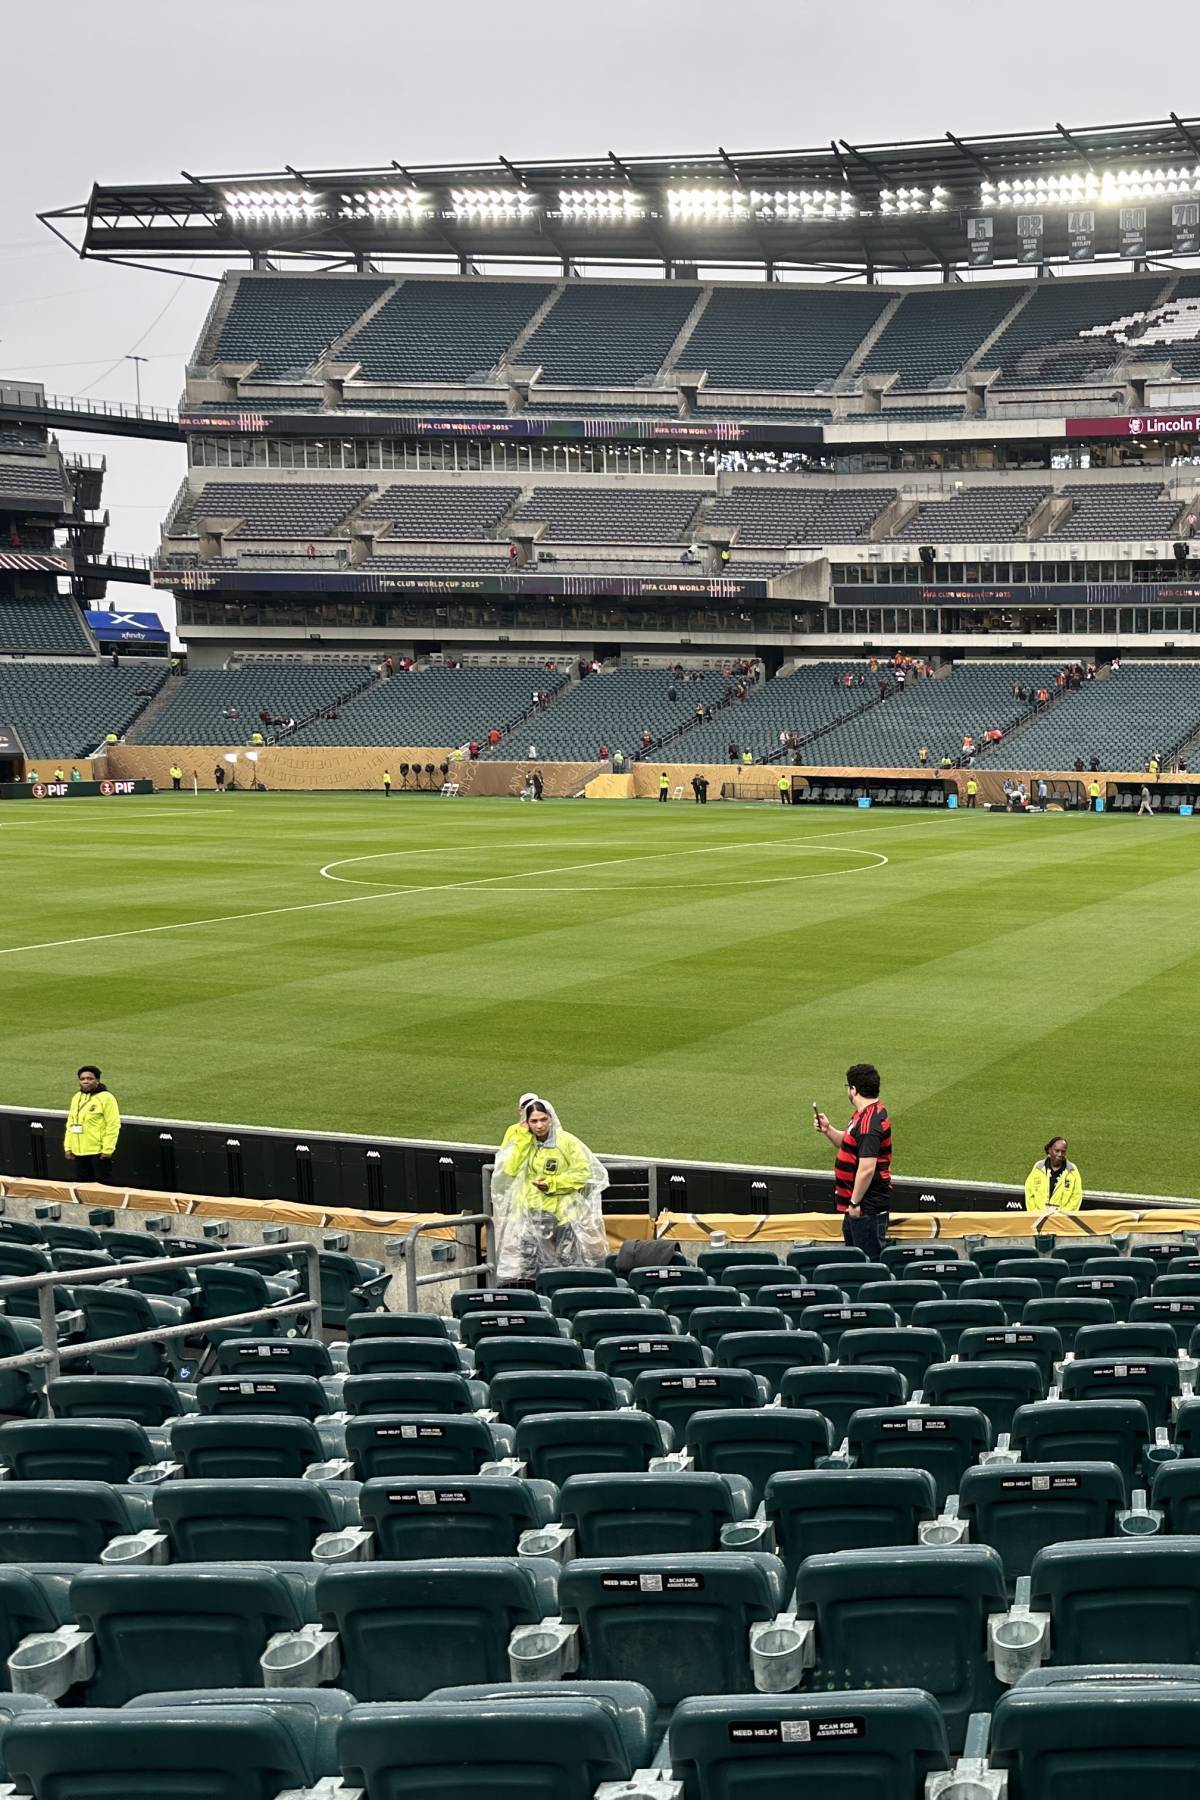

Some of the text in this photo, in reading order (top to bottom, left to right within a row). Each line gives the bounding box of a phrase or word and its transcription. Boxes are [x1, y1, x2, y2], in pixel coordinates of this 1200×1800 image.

[1070, 212, 1092, 233] 44
[1122, 209, 1144, 230] 60
[1175, 206, 1197, 226] 70
[975, 219, 986, 240] 5
[1019, 215, 1041, 237] 92
[1147, 417, 1193, 432] Lincoln
[121, 632, 145, 640] xfinity
[47, 783, 69, 796] PIF
[115, 782, 135, 793] PIF
[817, 1728, 858, 1736] ASSISTANCE
